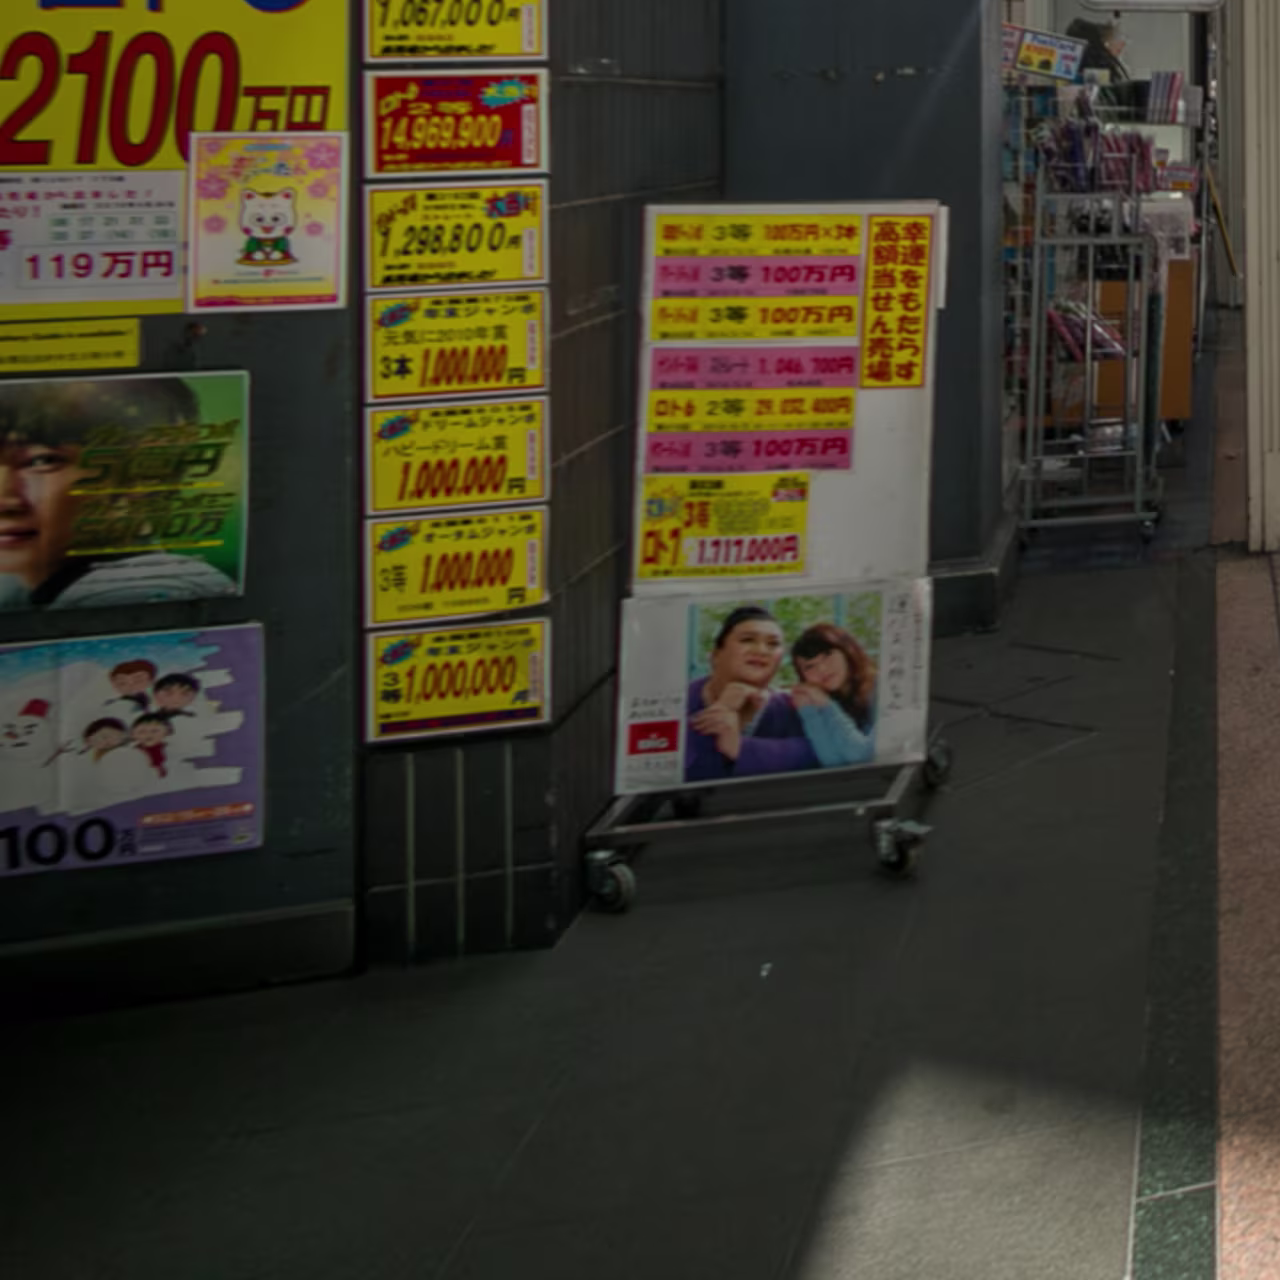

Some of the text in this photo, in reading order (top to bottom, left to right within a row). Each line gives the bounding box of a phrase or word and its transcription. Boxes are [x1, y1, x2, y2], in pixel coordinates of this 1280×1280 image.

[25, 249, 174, 280] 119万円
[709, 264, 751, 284] 3等
[761, 264, 856, 284] 100万円
[708, 305, 749, 325] 3等
[758, 304, 854, 325] 100万円
[703, 439, 744, 459] 3等
[753, 436, 848, 458] 100万円
